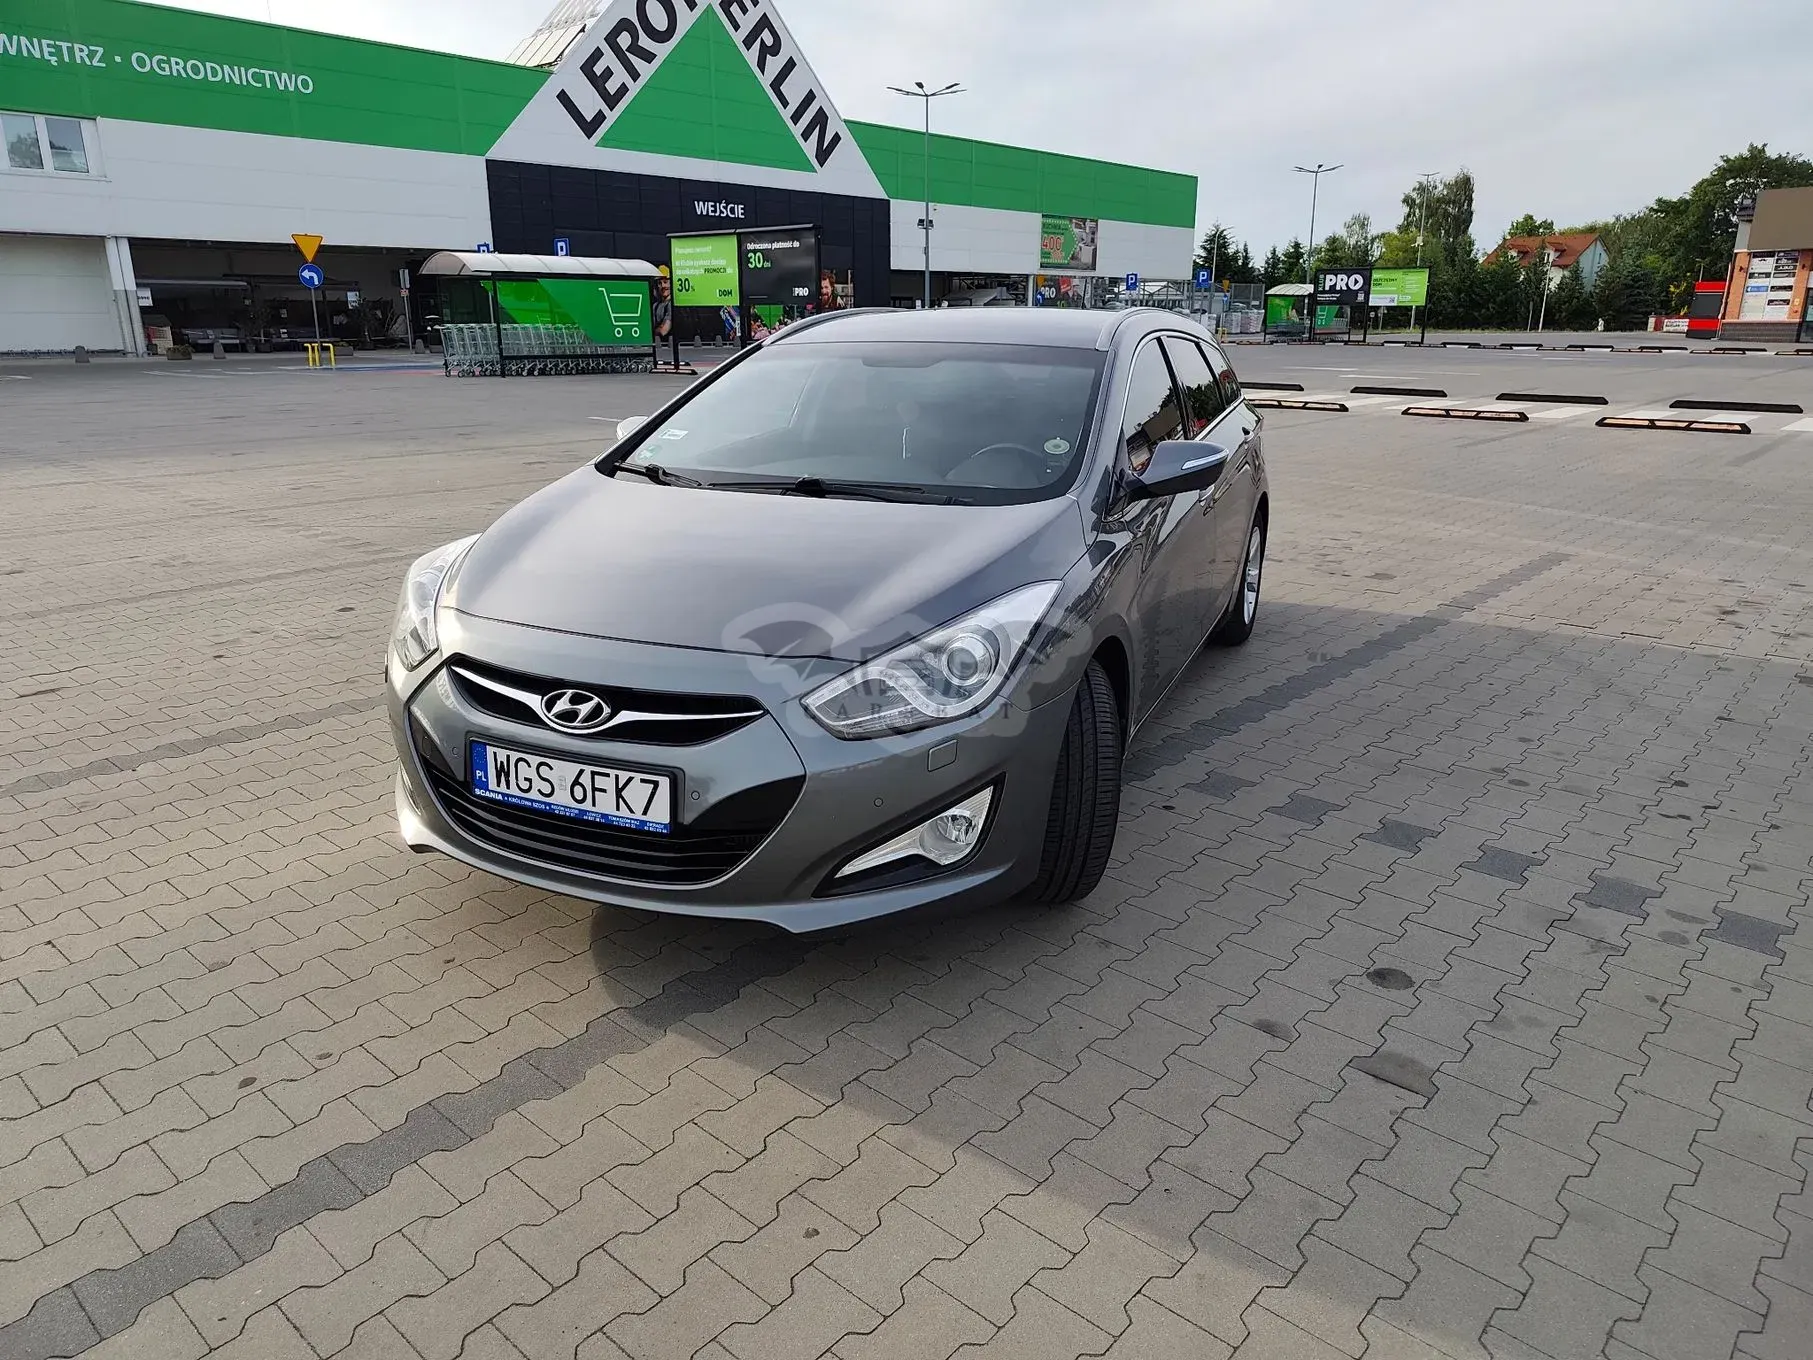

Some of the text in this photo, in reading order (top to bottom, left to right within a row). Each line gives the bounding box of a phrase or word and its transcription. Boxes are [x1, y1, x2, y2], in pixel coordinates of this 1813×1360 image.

[0, 33, 314, 94] WNĘTRZ OGRODNICTWO
[719, 0, 842, 168] ERLIN
[694, 199, 745, 219] WEJŚCIE
[746, 240, 800, 250] Odroczona płatność do
[747, 251, 771, 268] 30 dni
[1128, 275, 1136, 285] P
[1200, 271, 1207, 282] P
[1324, 273, 1364, 291] PRO
[718, 289, 733, 297] DOM
[794, 287, 809, 297] PRO
[475, 770, 487, 782] PL
[492, 751, 660, 816] WGS 6FK7
[474, 788, 503, 800] SCANIA
